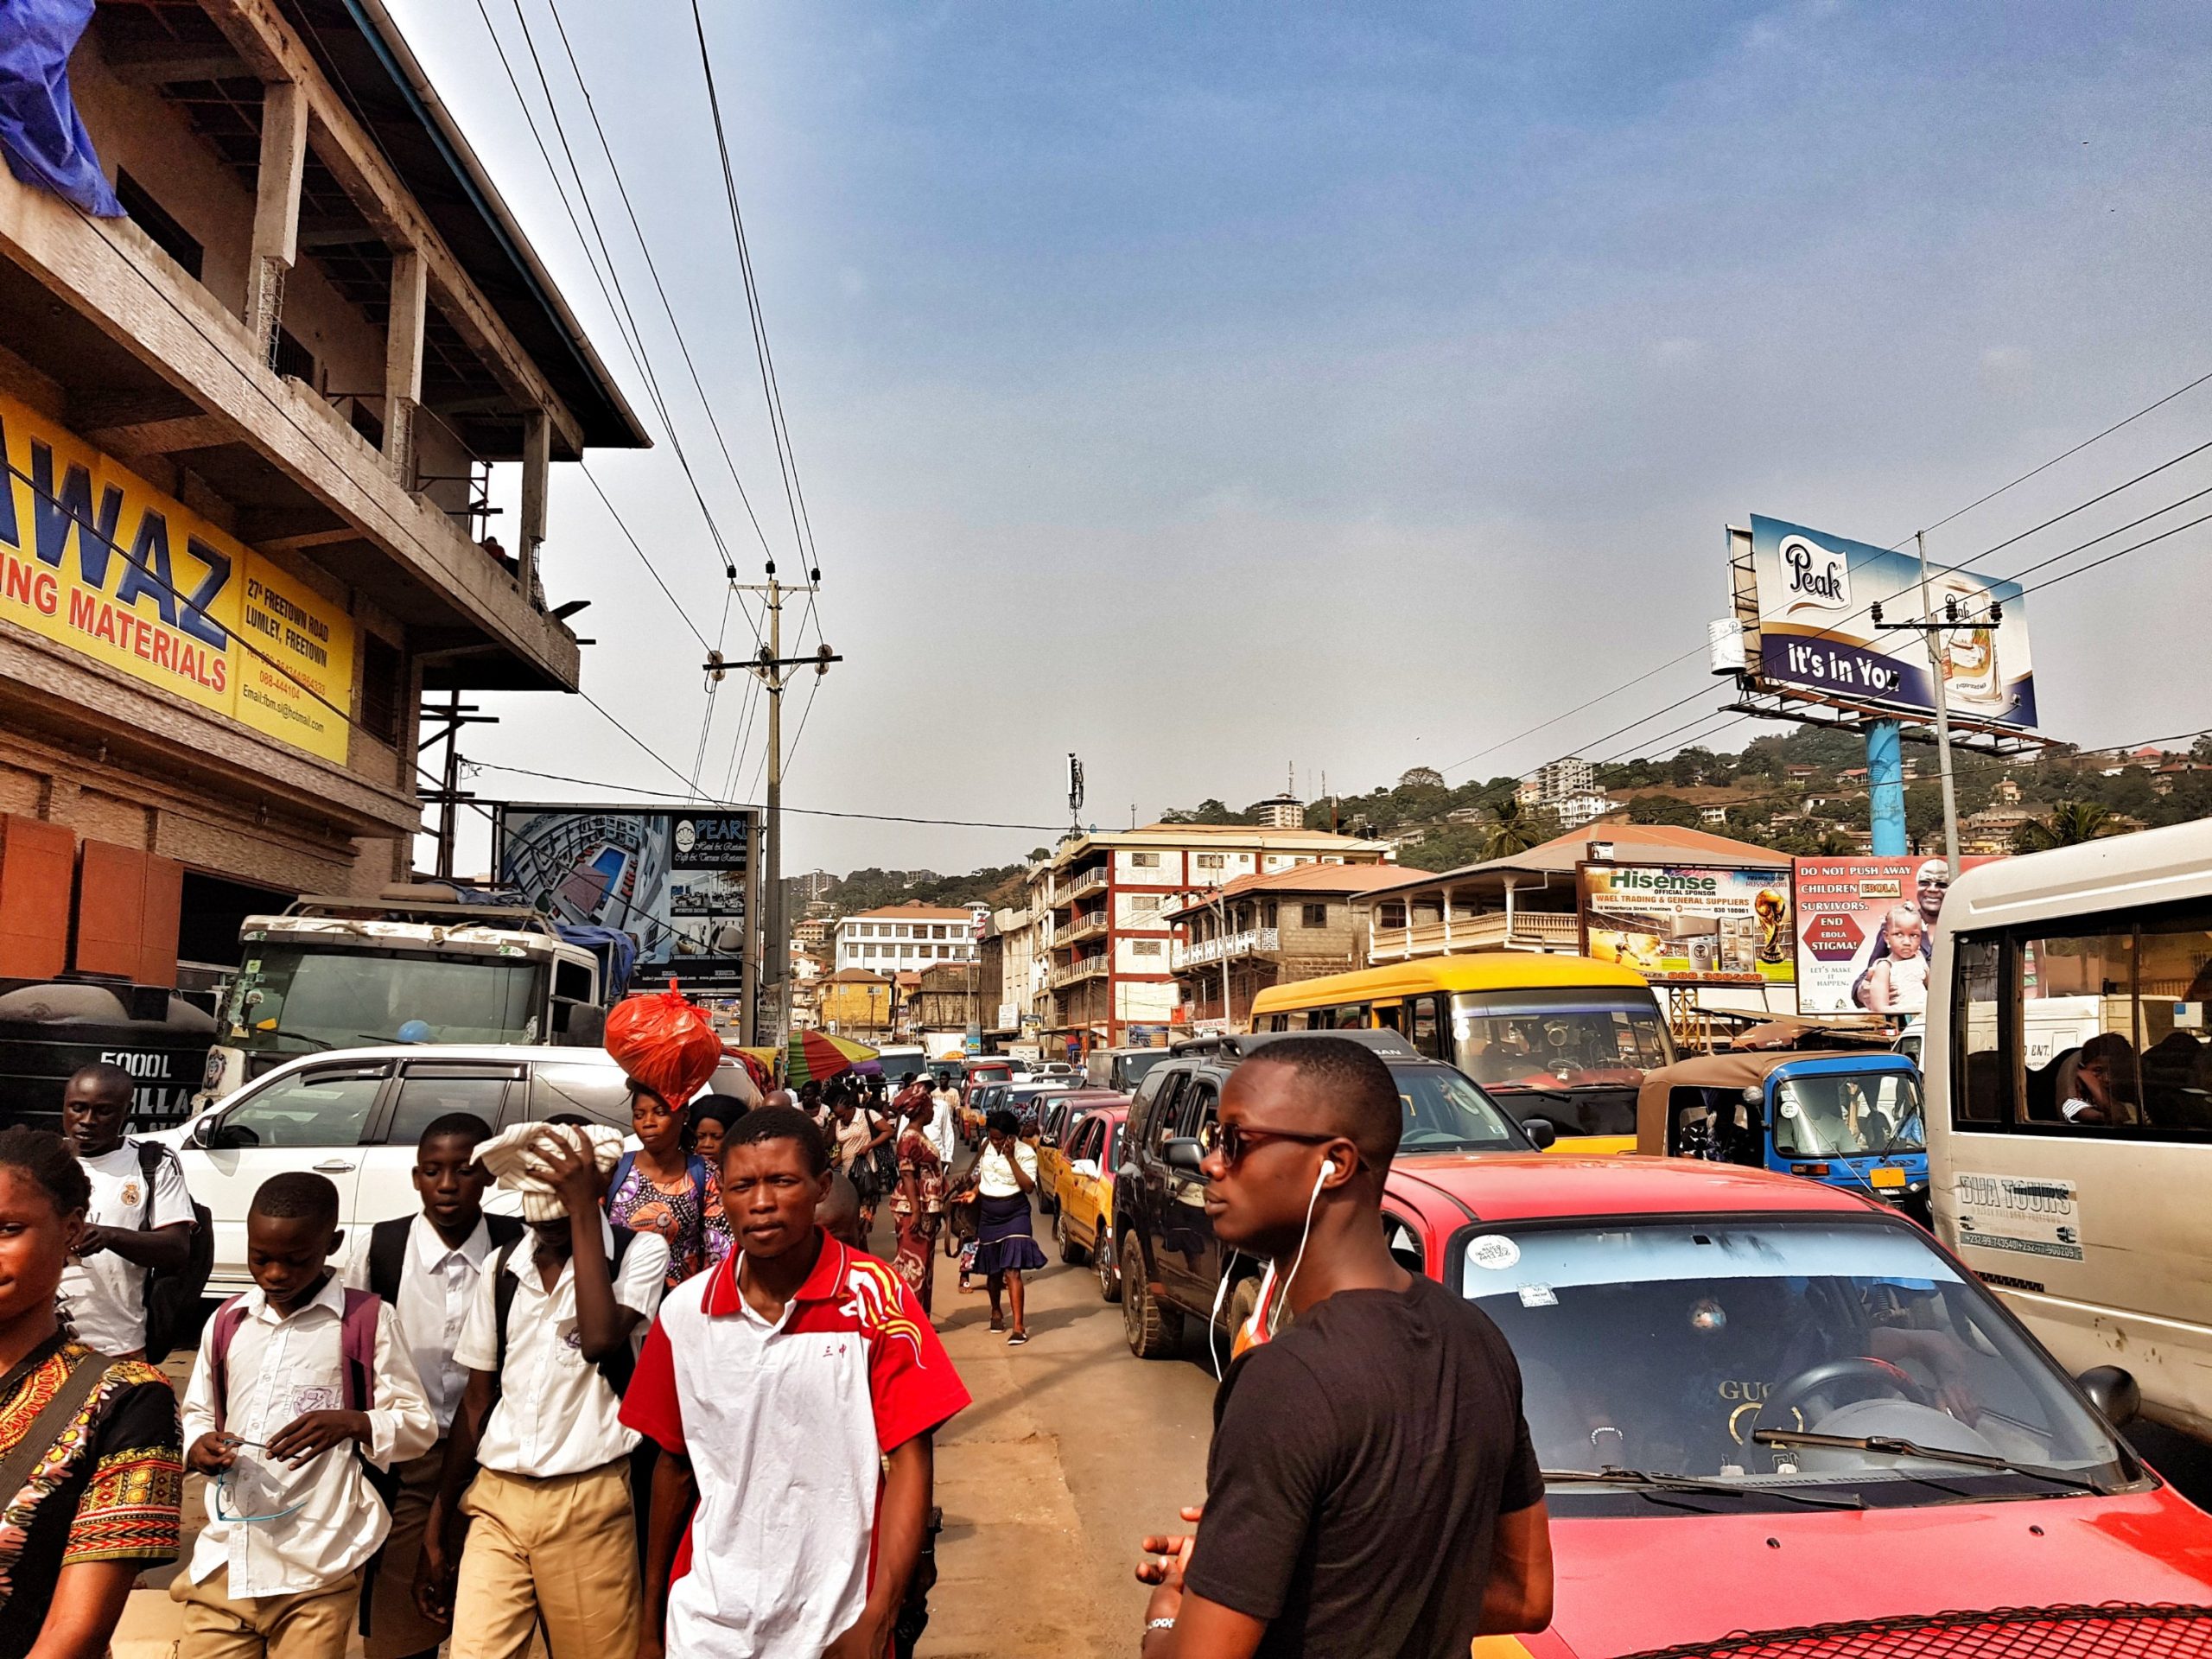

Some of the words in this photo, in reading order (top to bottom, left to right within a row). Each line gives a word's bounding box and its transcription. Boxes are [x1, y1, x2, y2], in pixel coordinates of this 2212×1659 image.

[1785, 543, 1844, 601] Peak
[264, 588, 307, 629] FREETOWN
[308, 615, 328, 642] ROAD
[69, 587, 226, 692] MATERIALS
[246, 605, 282, 644] LUMLEY,
[286, 628, 327, 668] FREETOWN
[1788, 643, 1824, 677] It's
[1829, 652, 1853, 683] In
[1610, 870, 1717, 890] Hisense
[1801, 867, 1817, 876] DO
[1822, 867, 1845, 875] NOT
[1849, 867, 1878, 875] PUSH
[1883, 866, 1911, 874] AWAY
[1801, 884, 1858, 893] CHILDREN
[1862, 884, 1897, 893] EBOLA
[1801, 901, 1869, 911] SURVIVORS.
[1812, 941, 1858, 950] STIGMA!
[2001, 1179, 2071, 1215] TOURS
